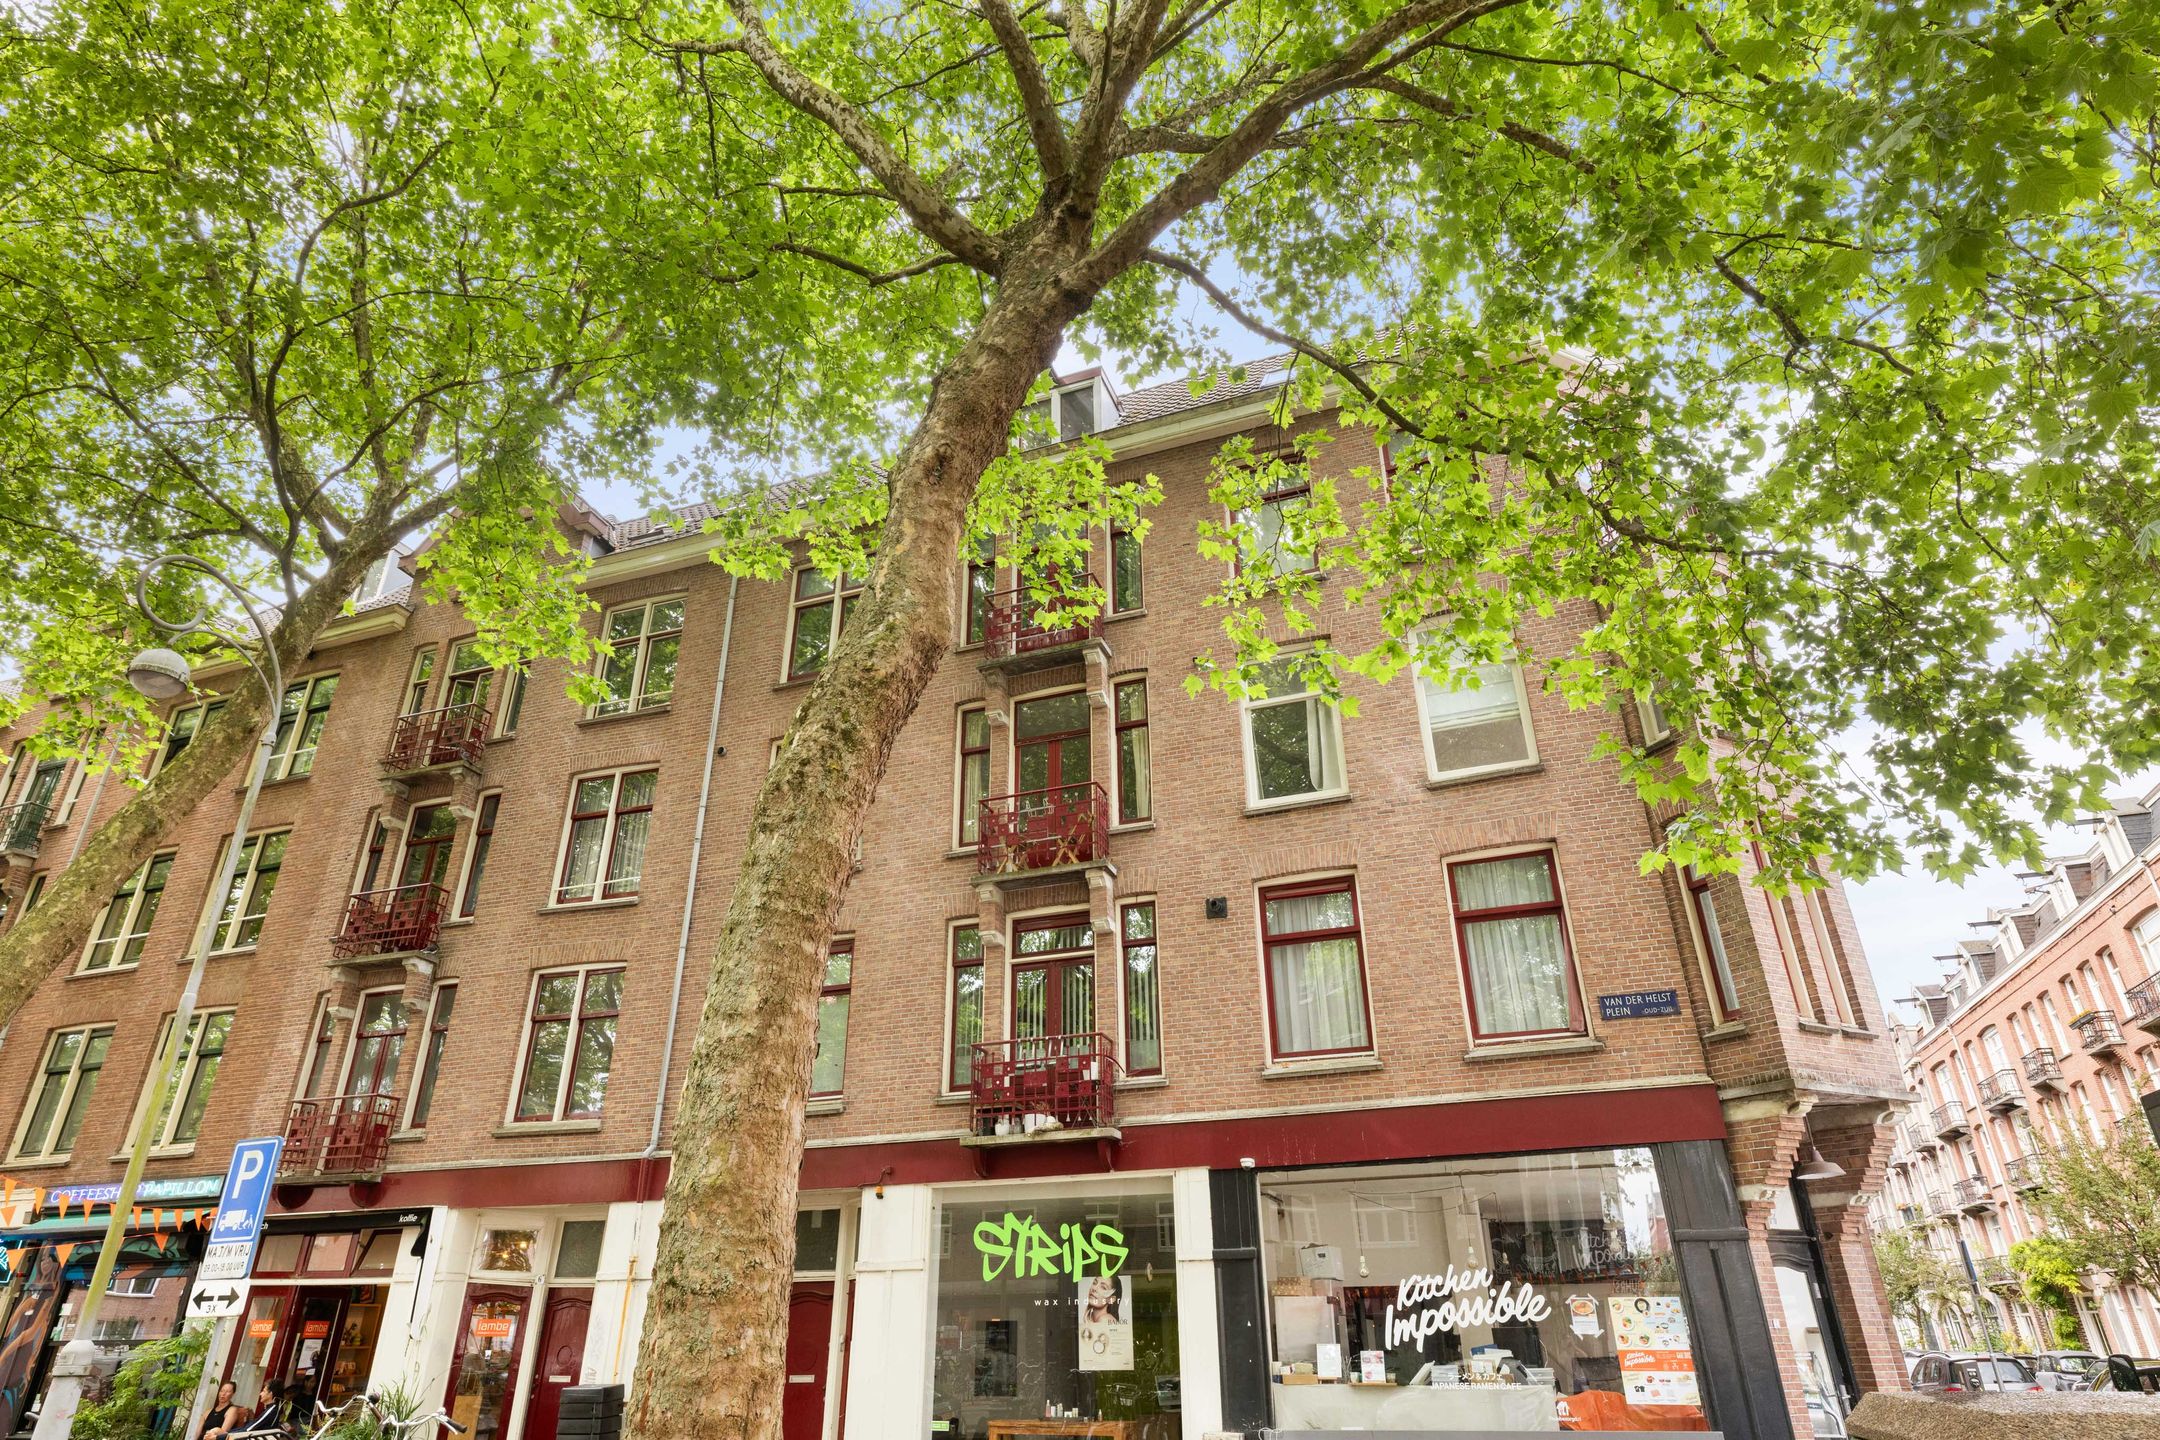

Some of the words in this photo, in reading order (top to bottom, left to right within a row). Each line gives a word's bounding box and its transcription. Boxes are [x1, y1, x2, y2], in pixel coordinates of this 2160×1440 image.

[1604, 997, 1623, 1006] VAN
[1625, 995, 1644, 1005] DER
[1645, 992, 1671, 1003] HELST
[1606, 1007, 1631, 1017] PLEIN
[231, 1149, 265, 1200] P
[143, 1179, 219, 1197] PAPILLON
[398, 1214, 418, 1223] koffie
[234, 1244, 251, 1257] VRIJ
[1396, 1264, 1493, 1311] Kitchen
[1068, 1297, 1129, 1306] industry
[1384, 1280, 1552, 1353] Impossible
[1430, 1382, 1470, 1391] JAPANESE
[1471, 1382, 1500, 1390] RAMEN
